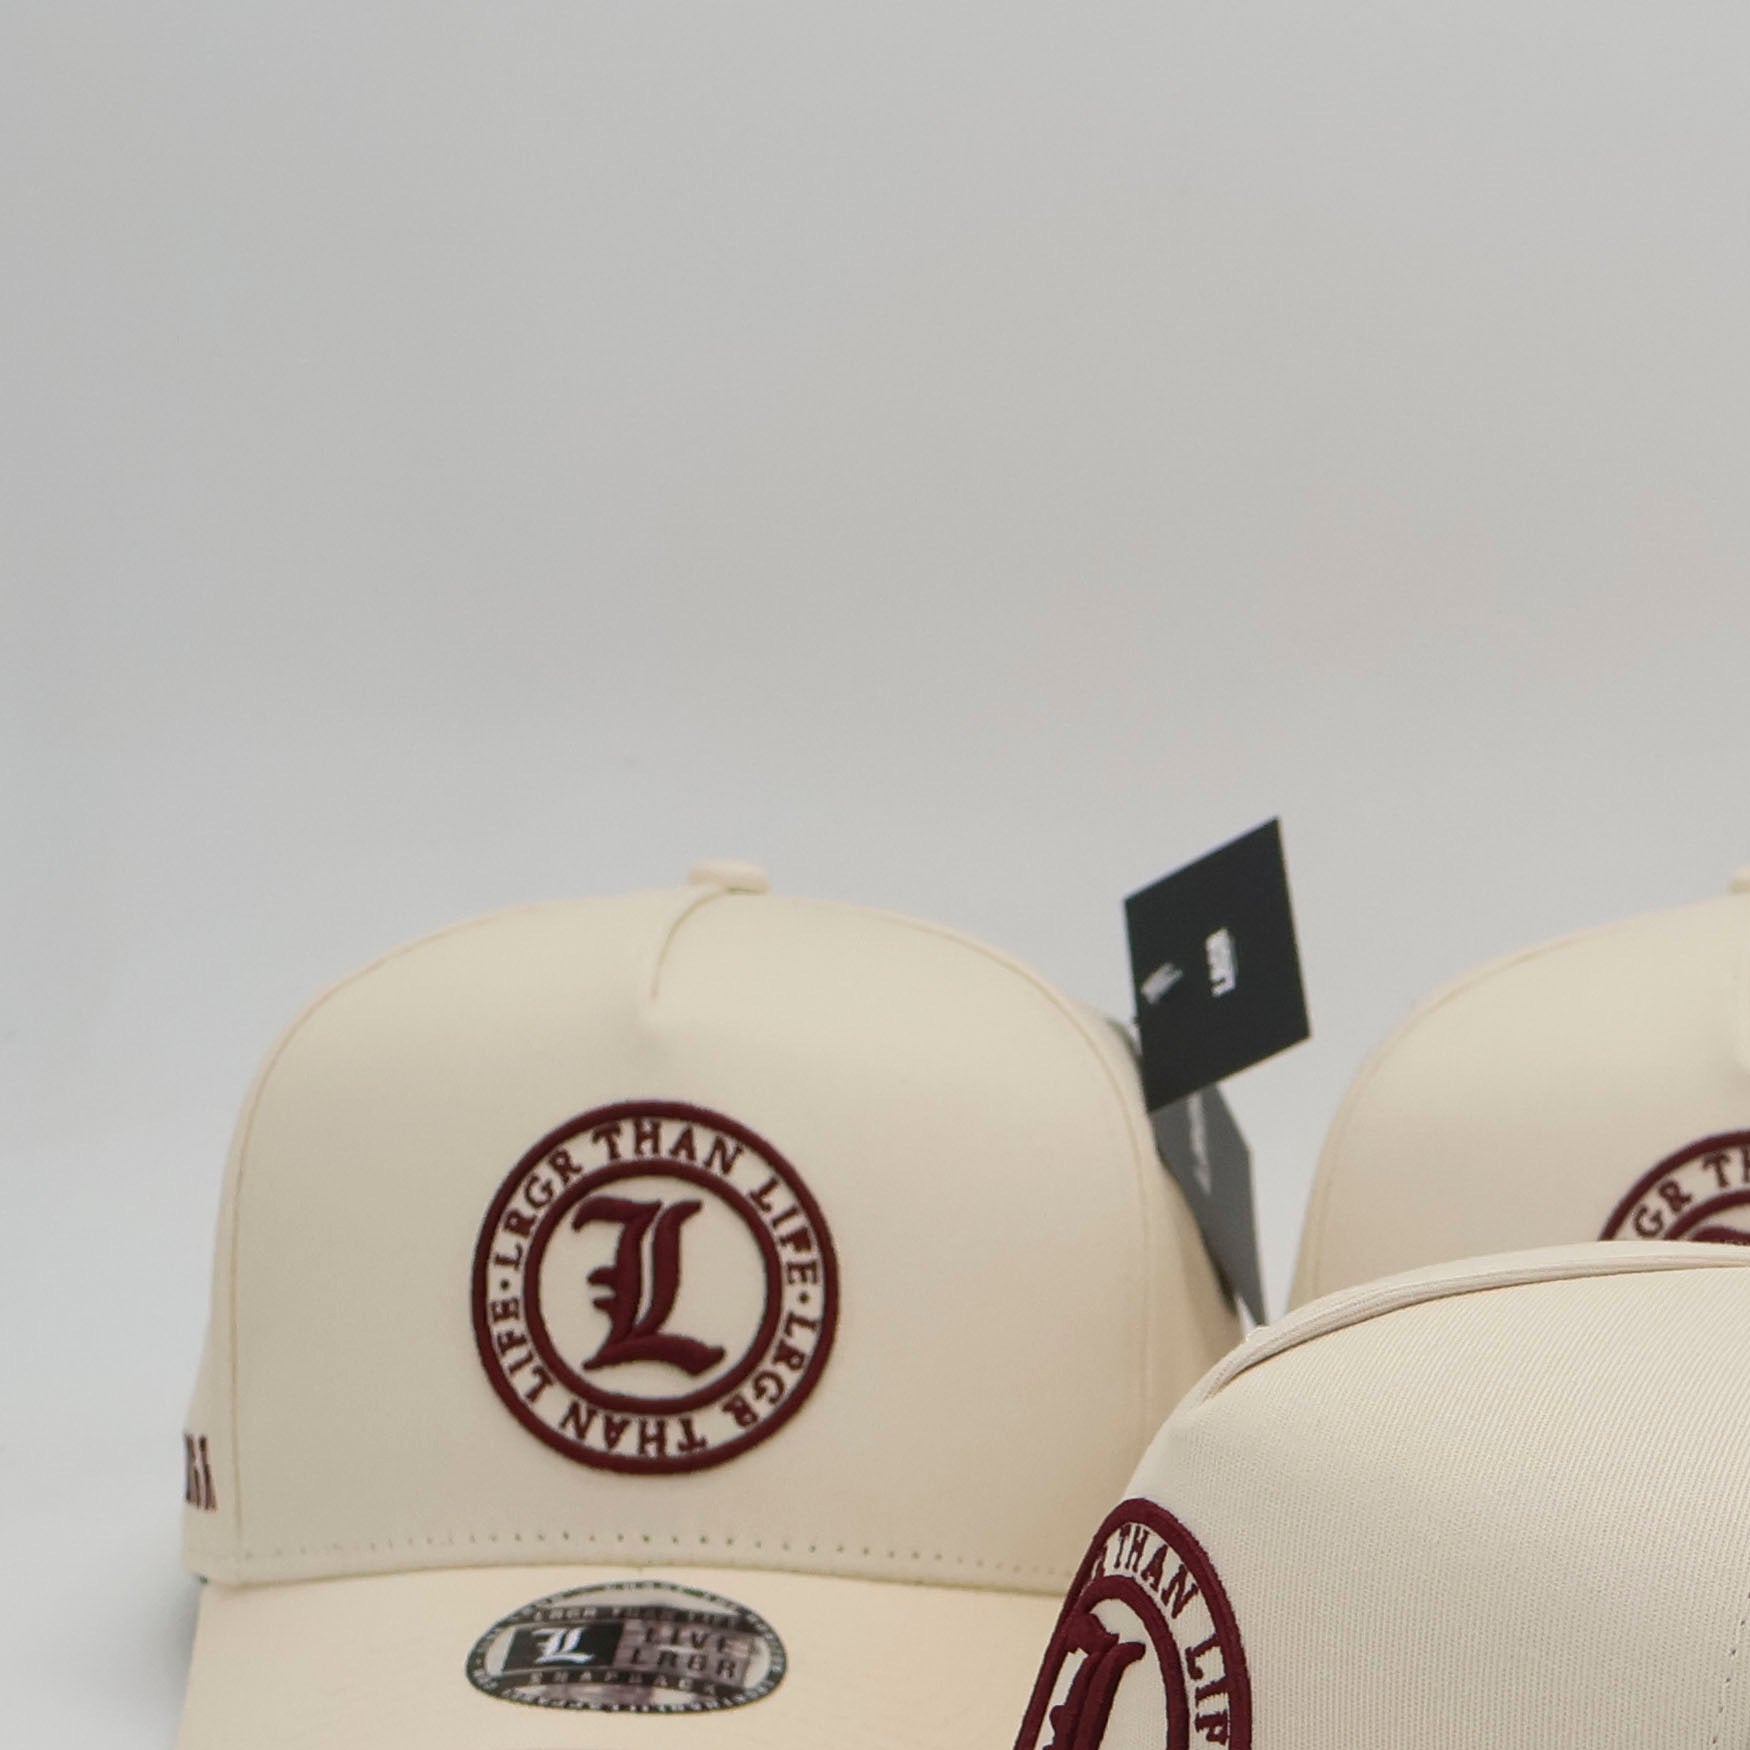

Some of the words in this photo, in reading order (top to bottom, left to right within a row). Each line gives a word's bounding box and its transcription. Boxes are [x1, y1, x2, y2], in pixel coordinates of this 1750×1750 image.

[494, 1149, 582, 1272] LRGR
[592, 1119, 744, 1175] THAN
[747, 1176, 818, 1285] LIFE
[572, 1195, 725, 1378] L
[491, 1298, 556, 1401] LIFE
[722, 1310, 818, 1428] LRGR
[558, 1397, 707, 1456] THAN
[1114, 1523, 1200, 1619] THAN
